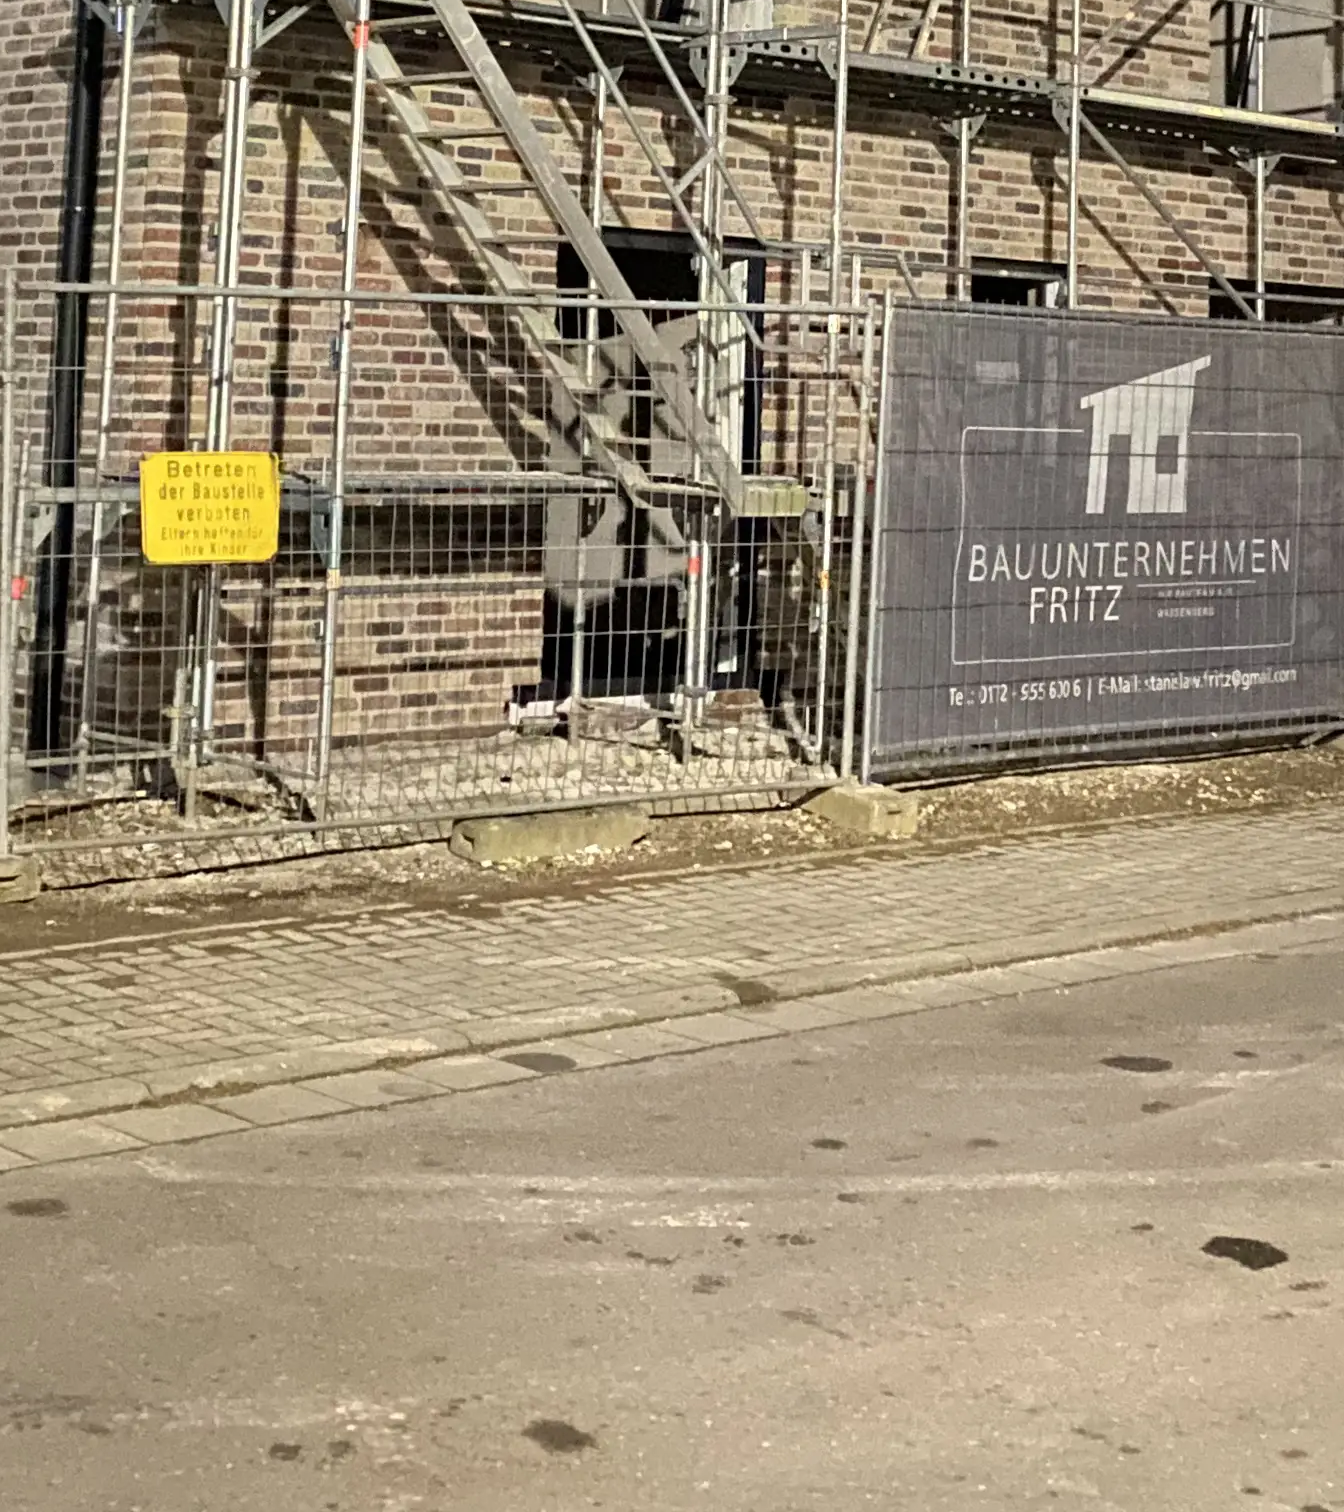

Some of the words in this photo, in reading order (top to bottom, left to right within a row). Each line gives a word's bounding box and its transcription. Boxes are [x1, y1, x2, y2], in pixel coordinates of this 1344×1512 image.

[167, 460, 256, 479] Betreten
[159, 483, 185, 500] der
[193, 482, 265, 500] Baustelle
[176, 505, 251, 522] verboten
[161, 526, 200, 541] Eltern
[203, 526, 243, 540] haften
[180, 543, 204, 557] ihre
[968, 538, 1291, 583] BAUUNTERNEHMEN
[1029, 584, 1124, 625] FRITZ
[949, 687, 975, 706] Te.:
